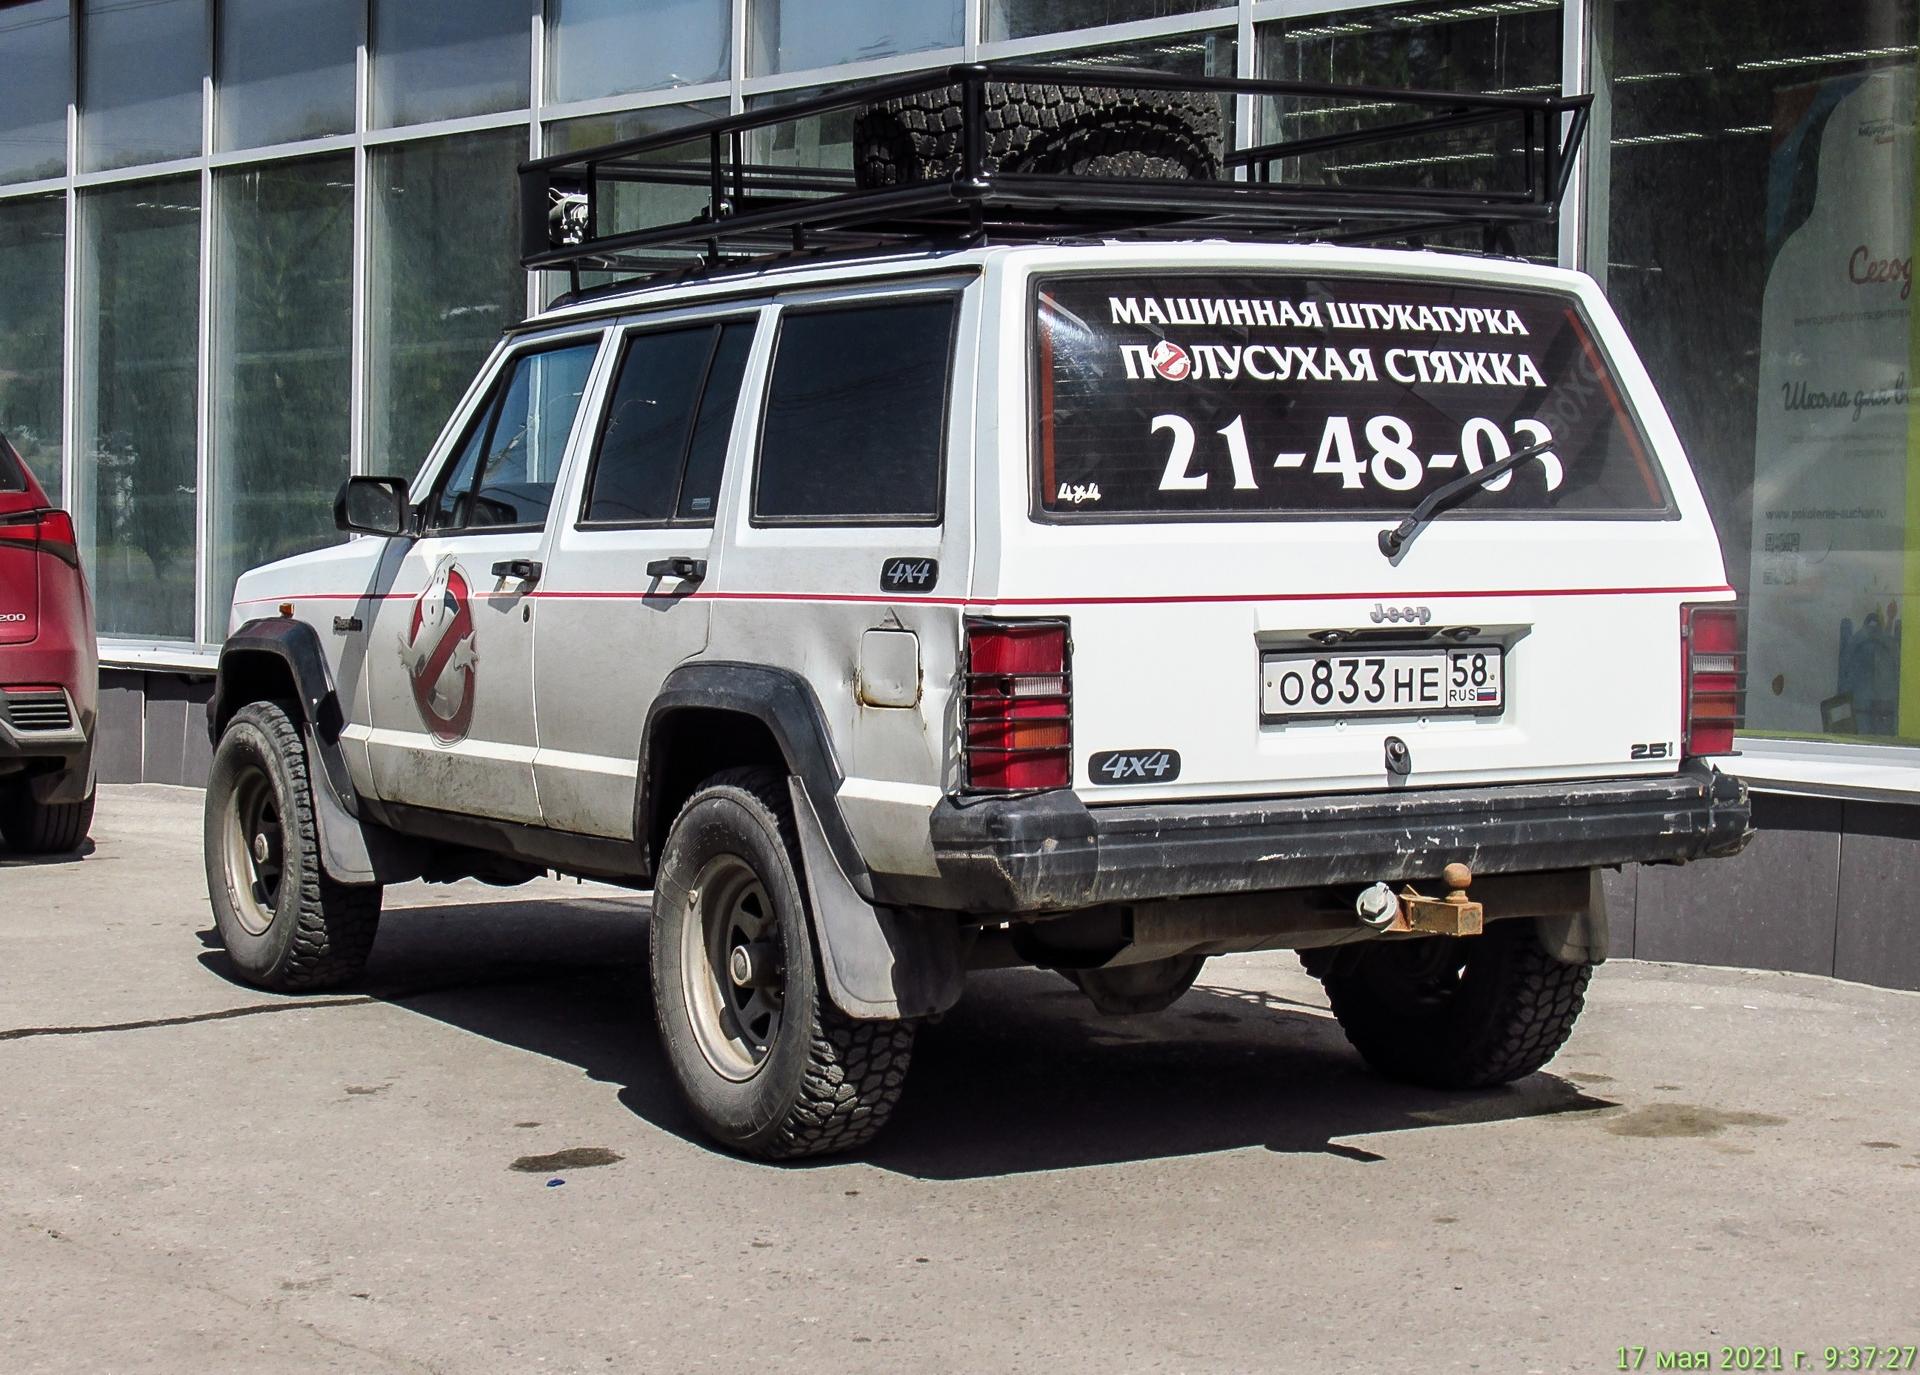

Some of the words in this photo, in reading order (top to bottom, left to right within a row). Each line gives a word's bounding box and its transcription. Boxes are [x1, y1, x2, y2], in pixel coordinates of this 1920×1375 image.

[1108, 297, 1324, 328] МАШИННАЯ
[1326, 302, 1530, 335] ШТУКАТУРКА
[1384, 348, 1548, 387] СТЯЖКА
[1151, 413, 1564, 492] 21-48-03
[887, 560, 930, 584] 4x4
[1370, 603, 1432, 625] Jeep
[1451, 653, 1488, 687] 58
[1449, 688, 1476, 702] RUS
[1102, 751, 1170, 779] 4x4
